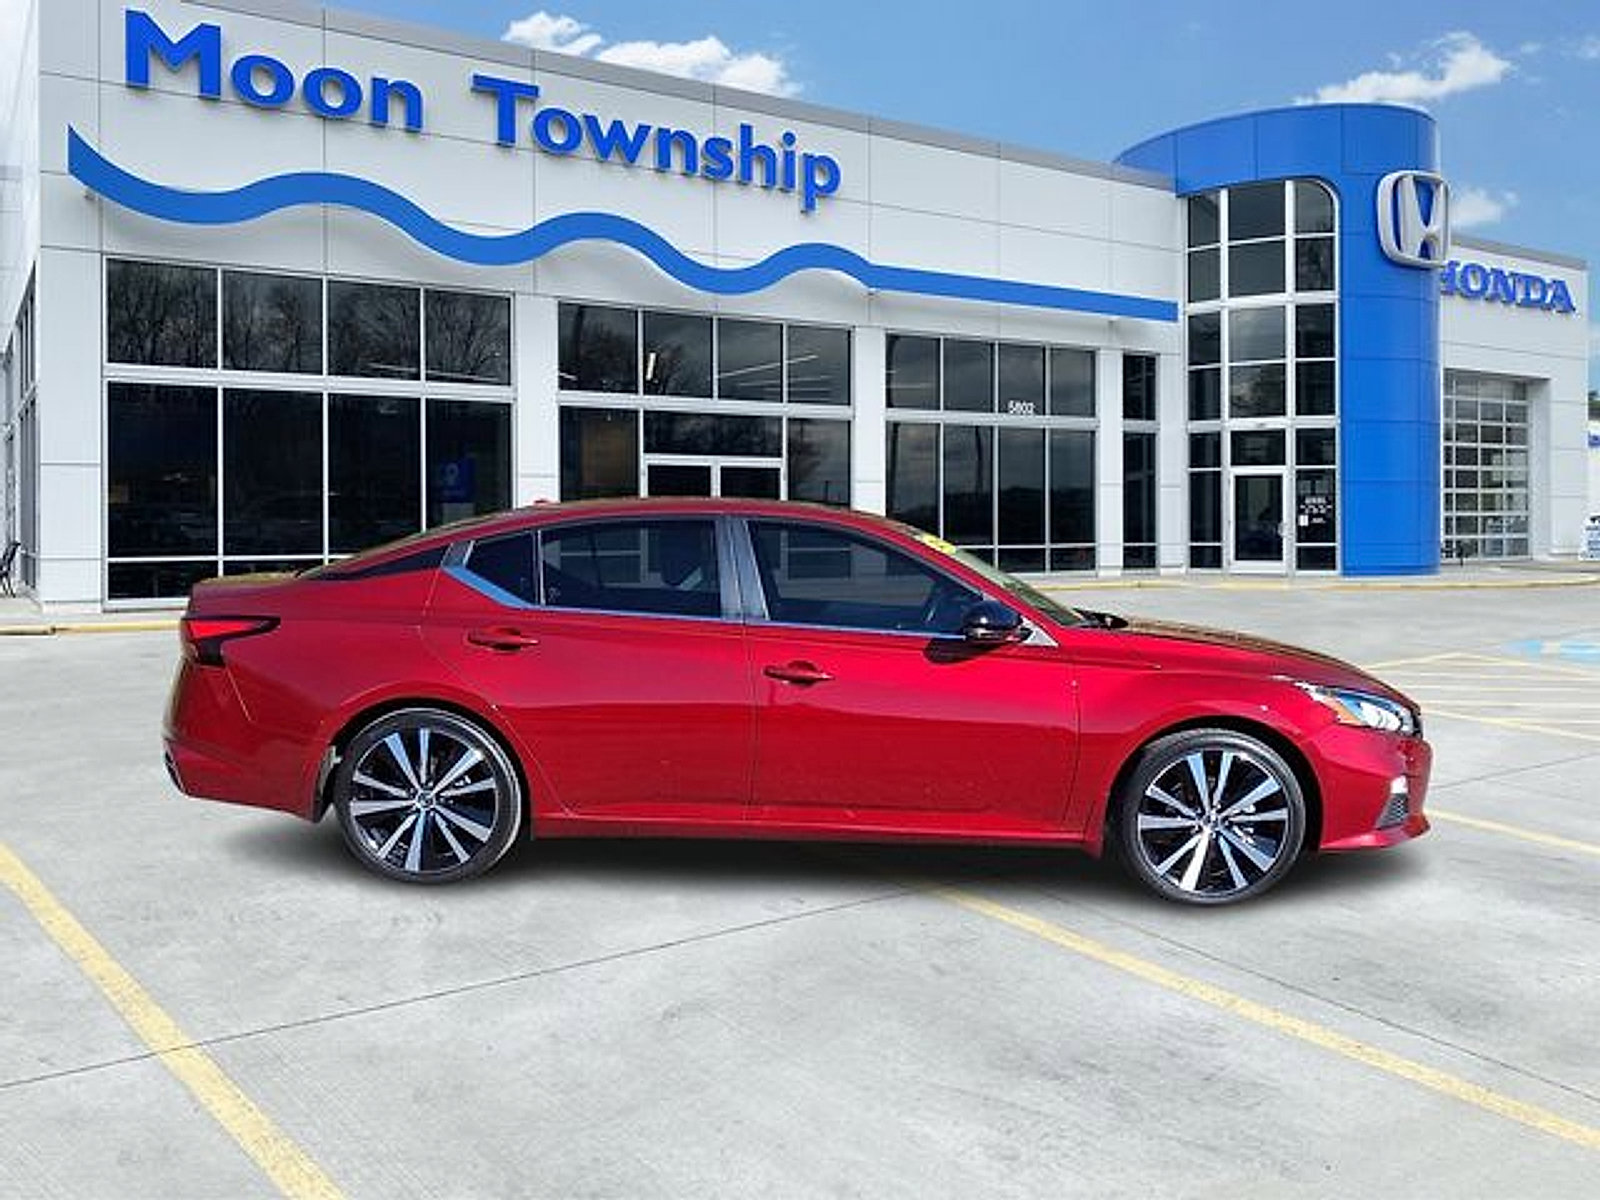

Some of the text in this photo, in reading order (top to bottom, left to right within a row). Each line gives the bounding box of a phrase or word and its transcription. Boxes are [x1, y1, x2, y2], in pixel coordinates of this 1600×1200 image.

[125, 10, 842, 213] Moon Township
[1441, 260, 1576, 313] HONDA
